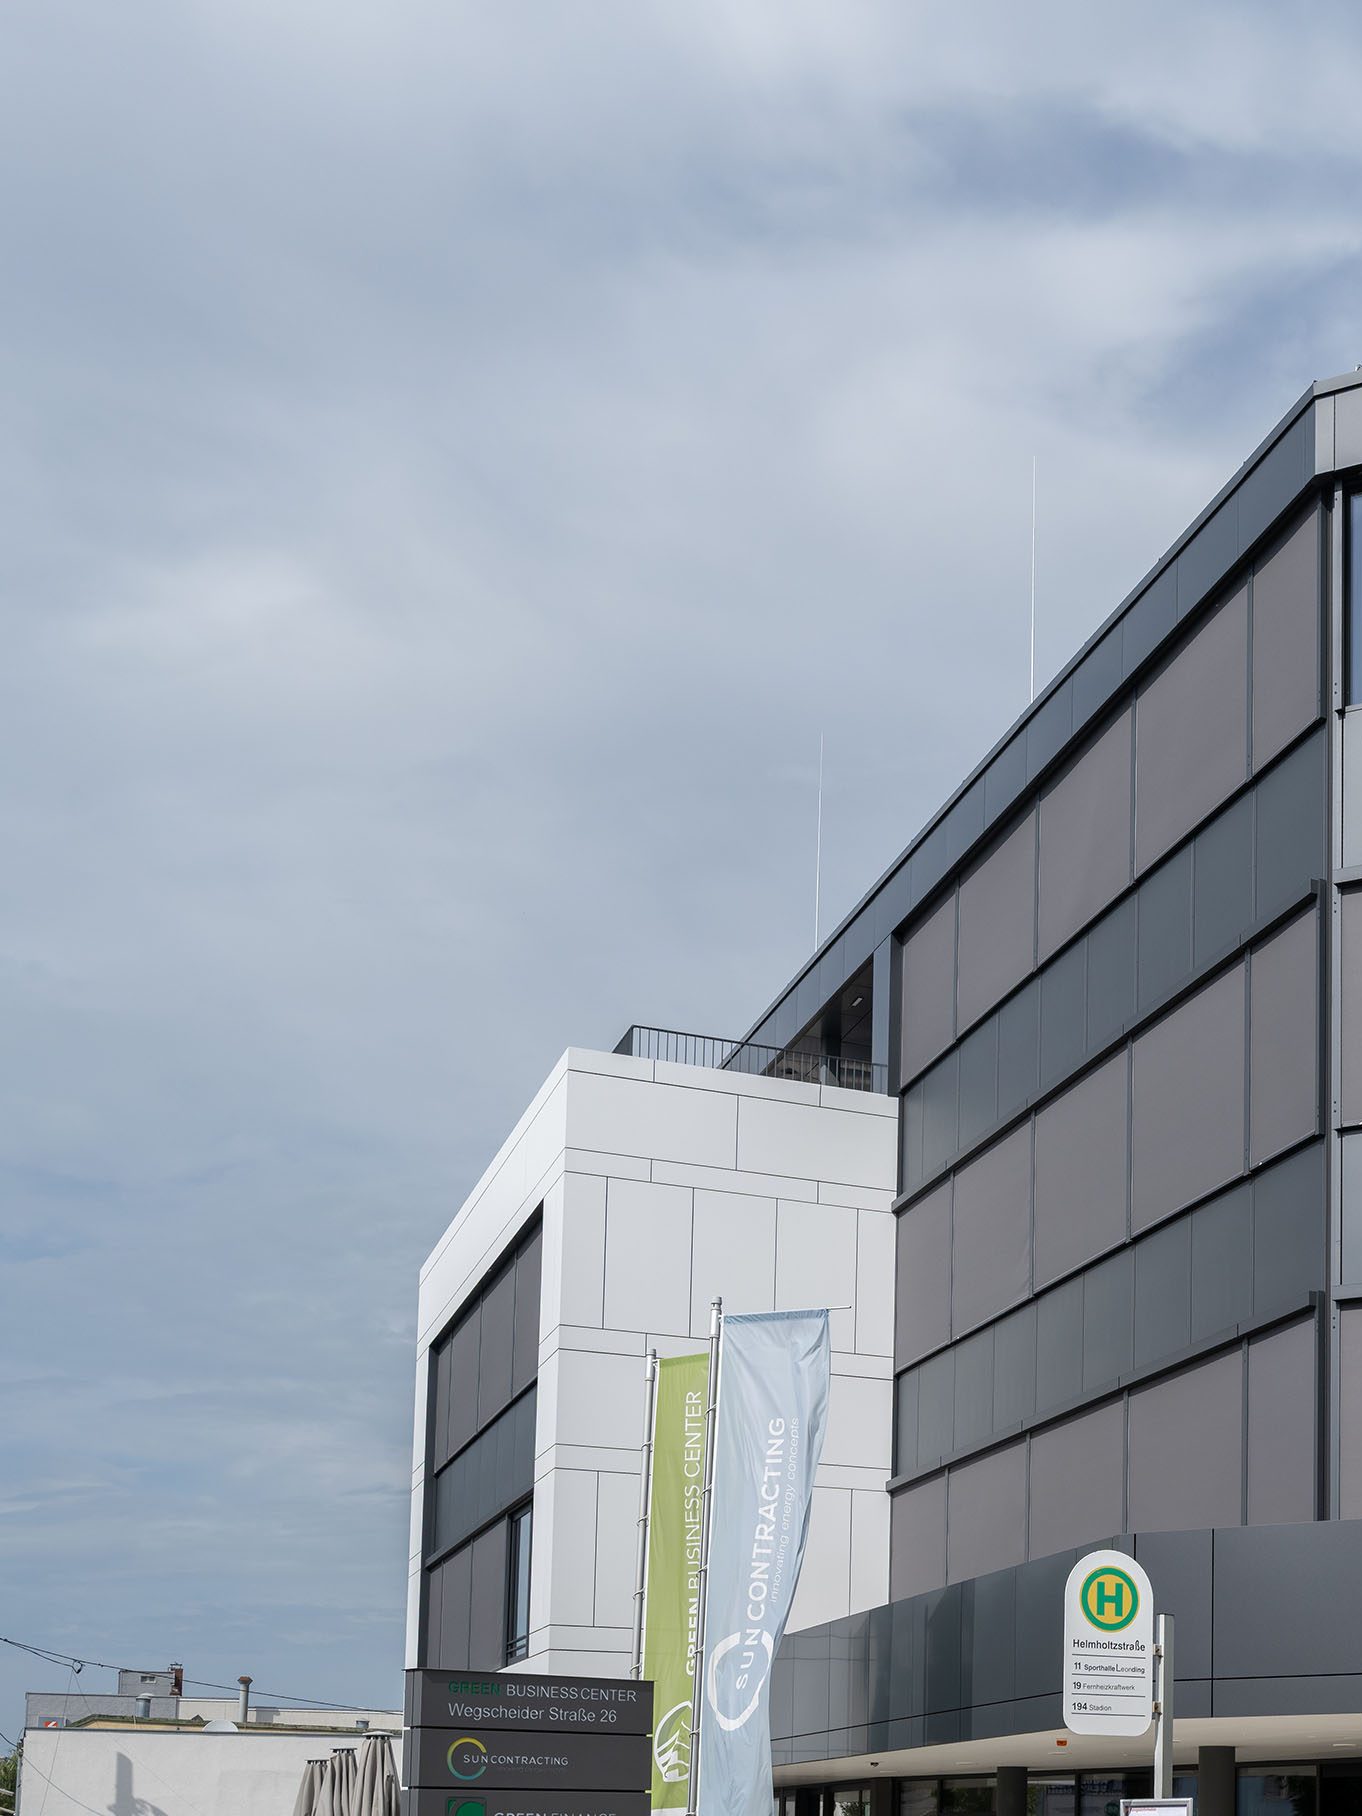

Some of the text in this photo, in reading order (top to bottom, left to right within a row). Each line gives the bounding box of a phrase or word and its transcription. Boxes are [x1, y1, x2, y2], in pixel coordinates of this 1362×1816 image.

[684, 1391, 702, 1478] CENTER
[769, 1417, 800, 1603] innovating energy concepts
[1096, 1581, 1124, 1617] H
[1072, 1639, 1146, 1652] Helmholtzstraße
[1073, 1661, 1081, 1670] 11
[1084, 1663, 1116, 1672] Sporthalle
[448, 1681, 501, 1697] GREEN
[1073, 1681, 1082, 1690] 19
[448, 1702, 617, 1723] Wegscheider Straße 26
[1072, 1702, 1112, 1712] 194 Stadion
